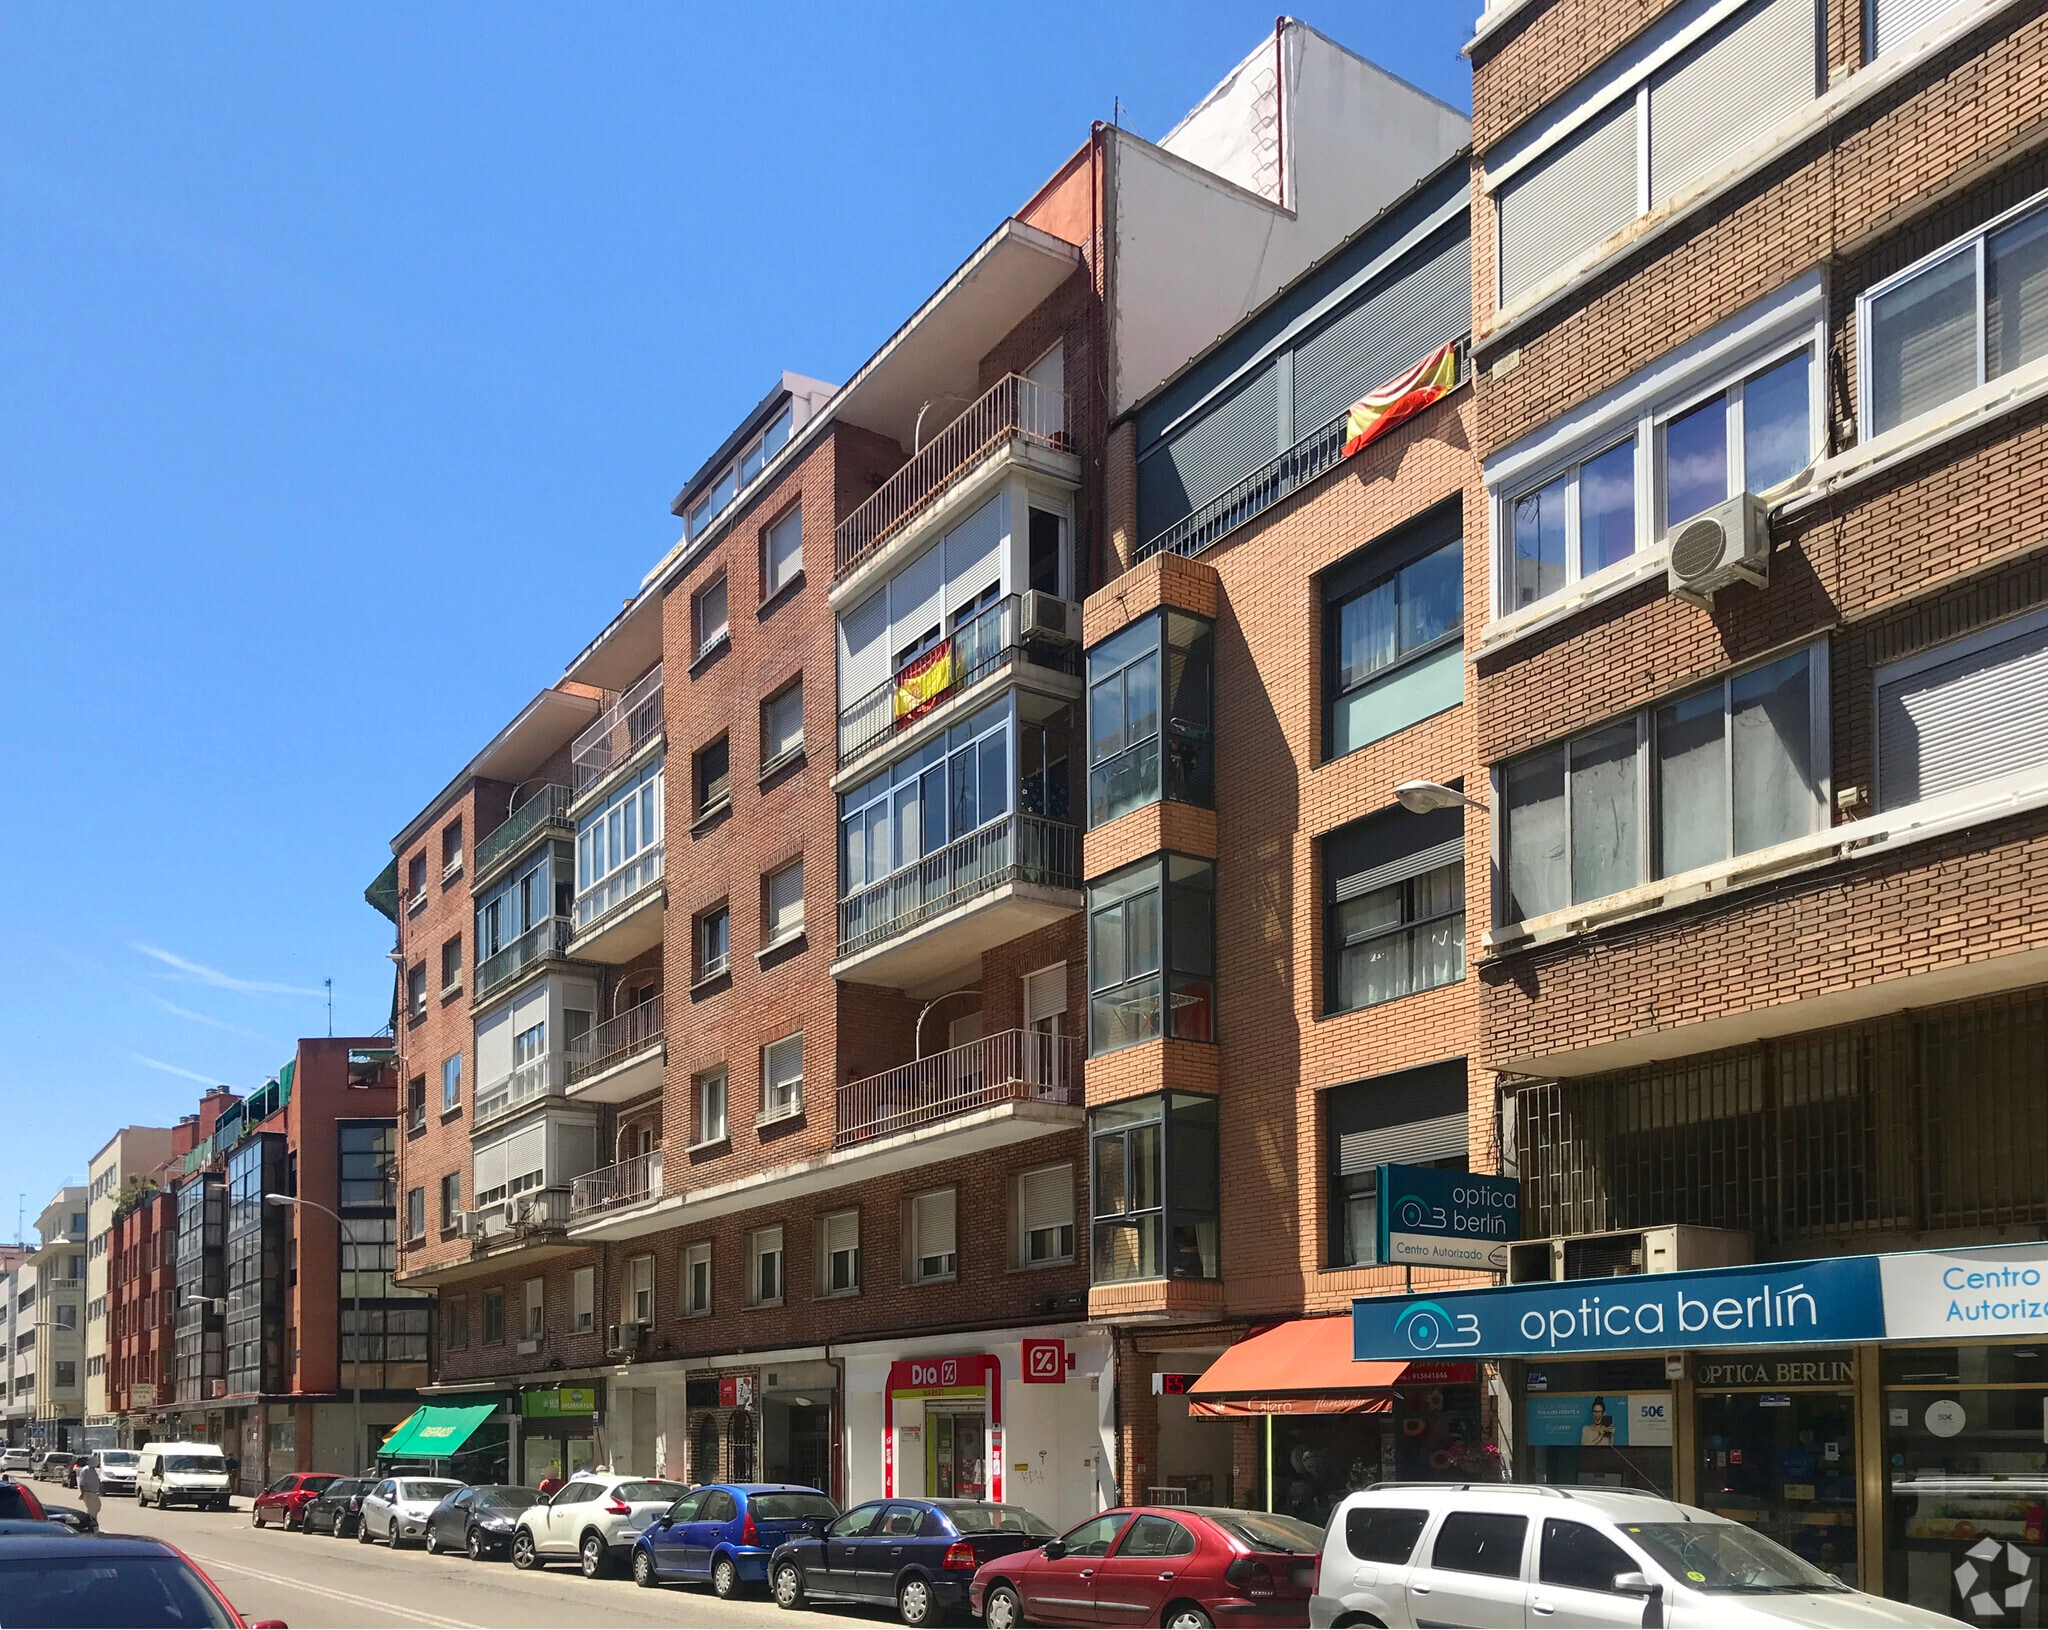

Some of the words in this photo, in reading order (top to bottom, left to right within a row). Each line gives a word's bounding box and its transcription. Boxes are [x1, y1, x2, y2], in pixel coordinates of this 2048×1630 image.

[1453, 1185, 1516, 1209] optica
[1396, 1242, 1429, 1255] Centro
[1432, 1246, 1483, 1260] Autorizado
[1943, 1266, 2040, 1290] Centro
[1520, 1297, 1664, 1347] optica
[1700, 1364, 1770, 1384] OPTICA
[1776, 1361, 1854, 1383] BERLIN
[923, 1388, 944, 1396] MARKET
[1641, 1405, 1664, 1418] 50€
